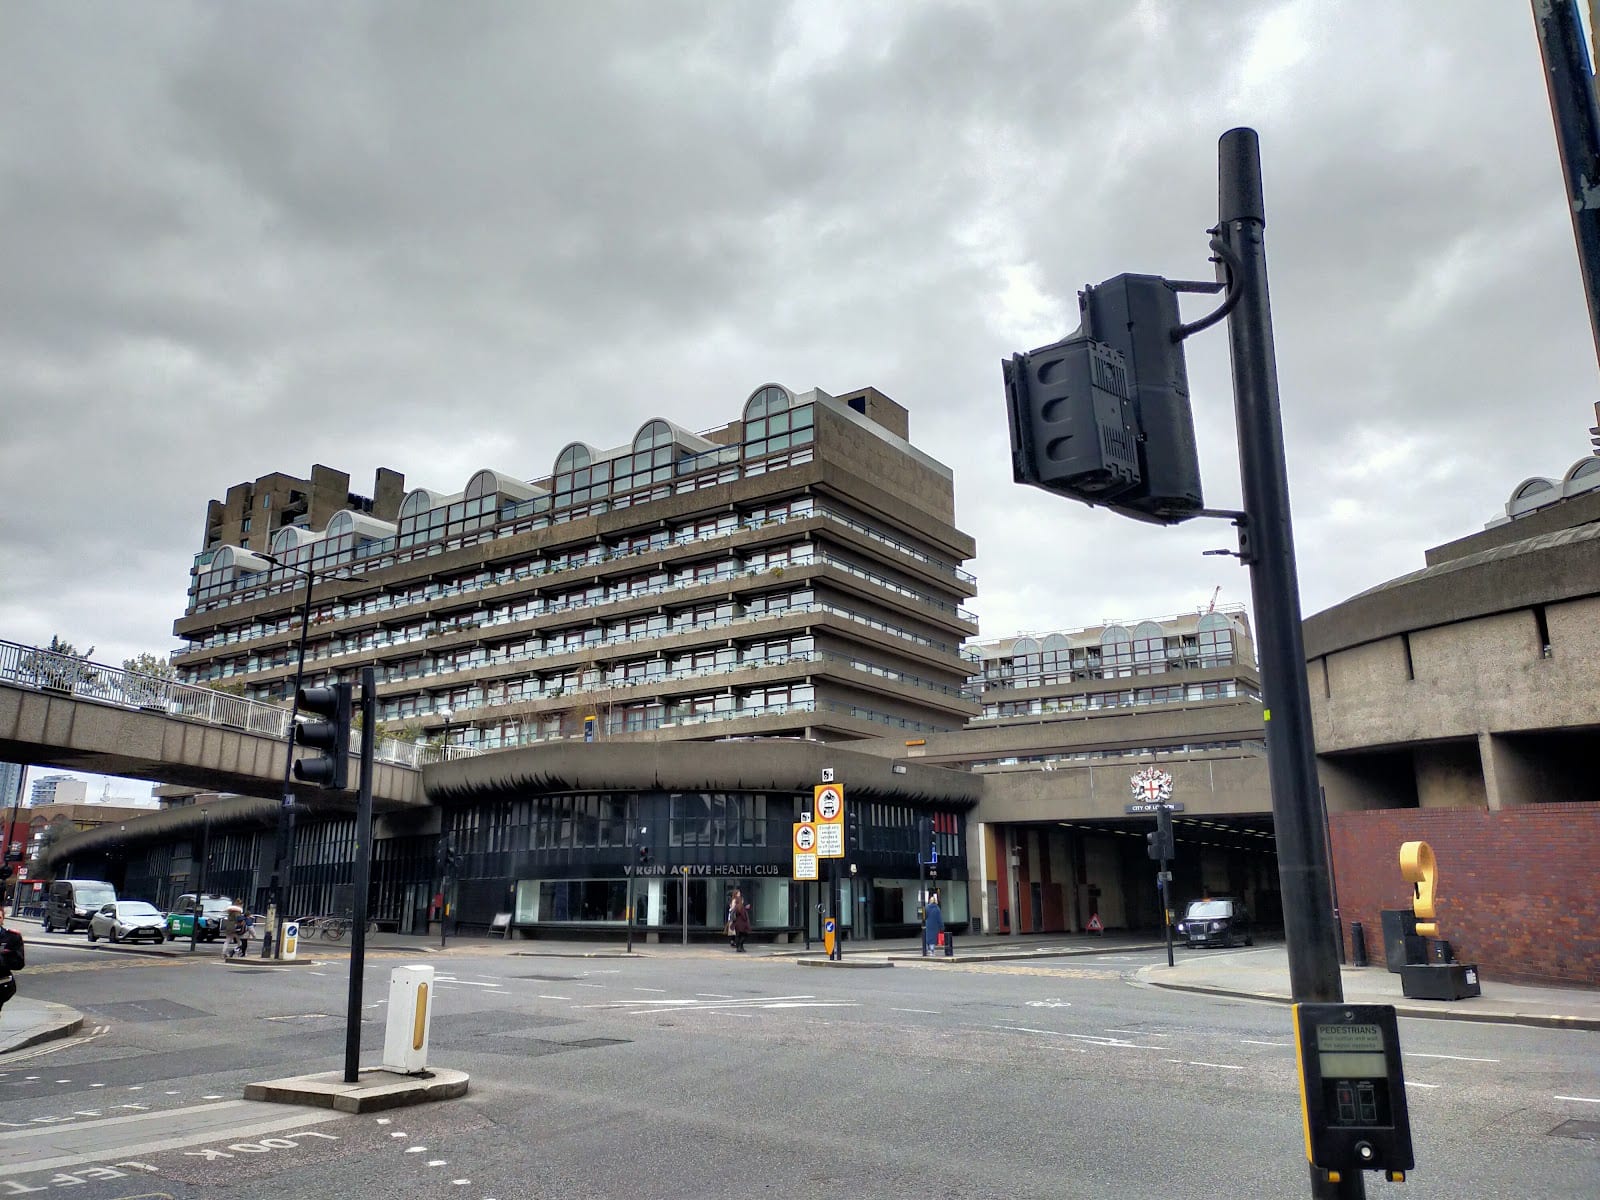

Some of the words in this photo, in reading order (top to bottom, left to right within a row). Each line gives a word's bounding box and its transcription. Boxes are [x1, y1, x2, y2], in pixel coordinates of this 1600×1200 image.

[623, 865, 666, 875] VRGIN
[714, 865, 751, 875] HEALTH
[754, 865, 779, 874] CLUB
[1320, 1026, 1377, 1035] PEDESTRIANS
[184, 1131, 340, 1161] LOOK
[0, 1161, 159, 1196] LEFT
